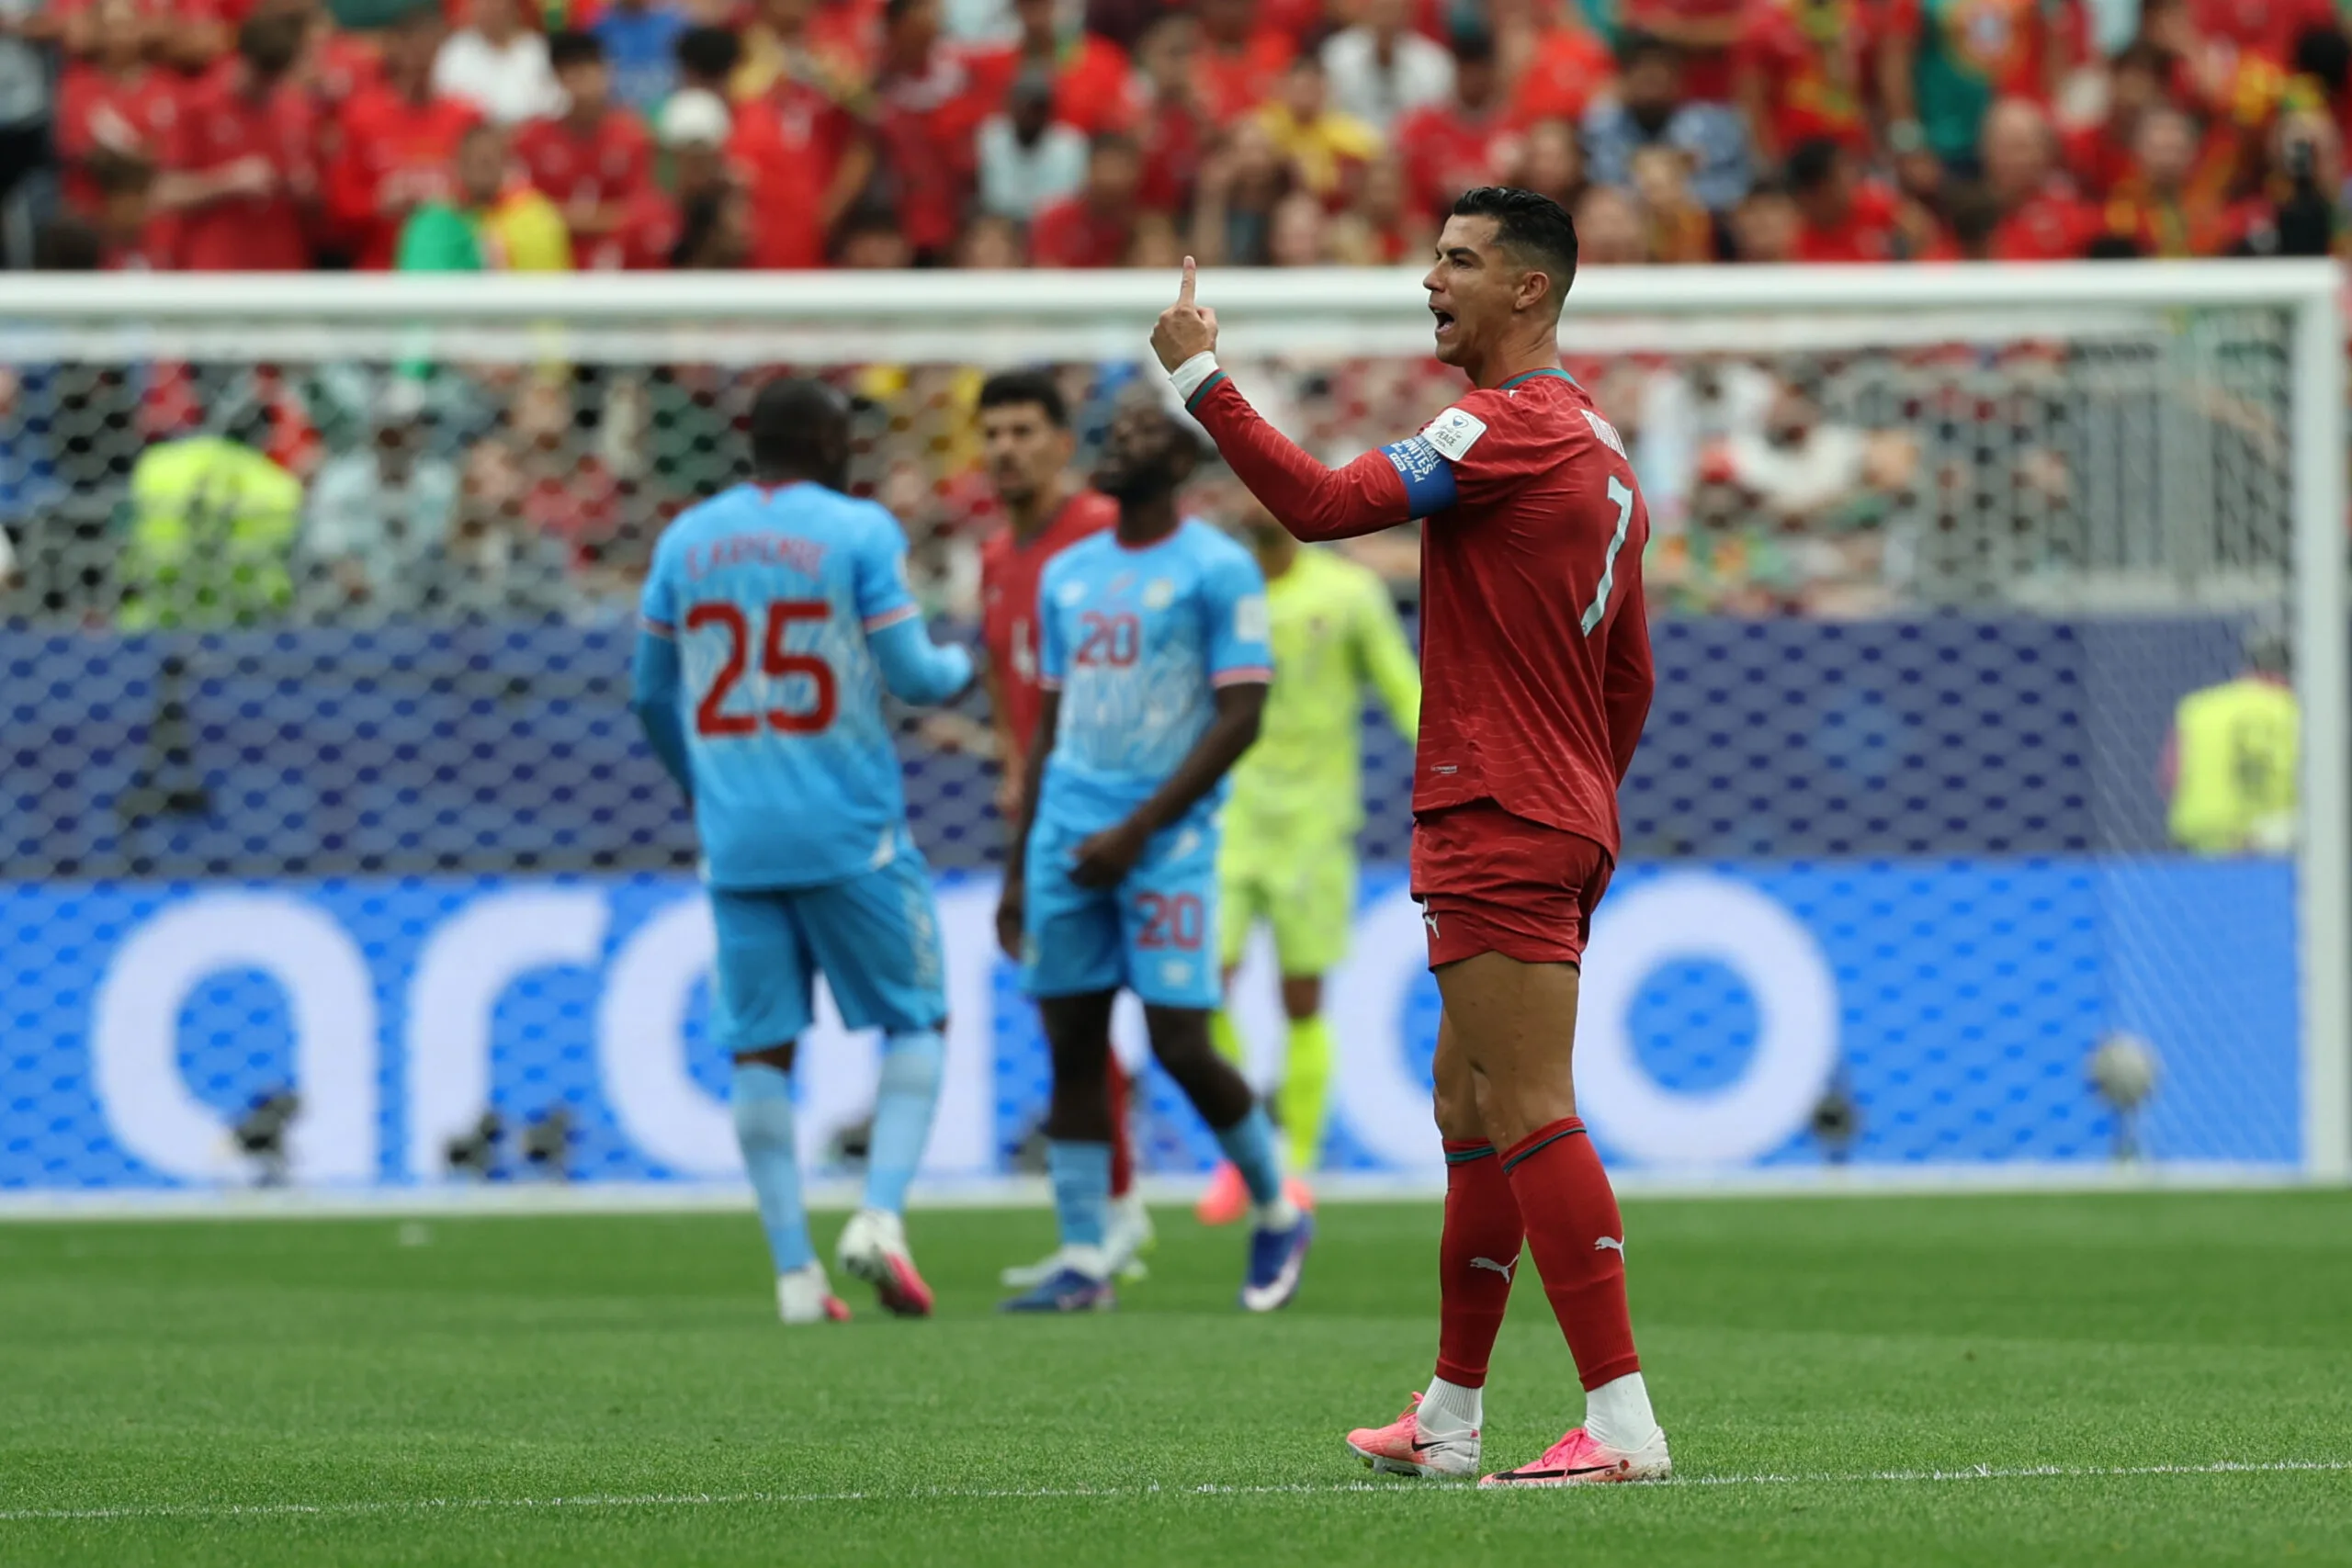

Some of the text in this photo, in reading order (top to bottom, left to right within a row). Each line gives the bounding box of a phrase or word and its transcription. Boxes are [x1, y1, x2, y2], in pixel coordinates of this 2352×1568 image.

[1402, 438, 1433, 475] UNITES
[1435, 431, 1457, 447] PEACE
[1400, 453, 1425, 482] World
[1075, 610, 1140, 668] 20
[685, 600, 837, 737] 25
[1135, 891, 1203, 952] 20
